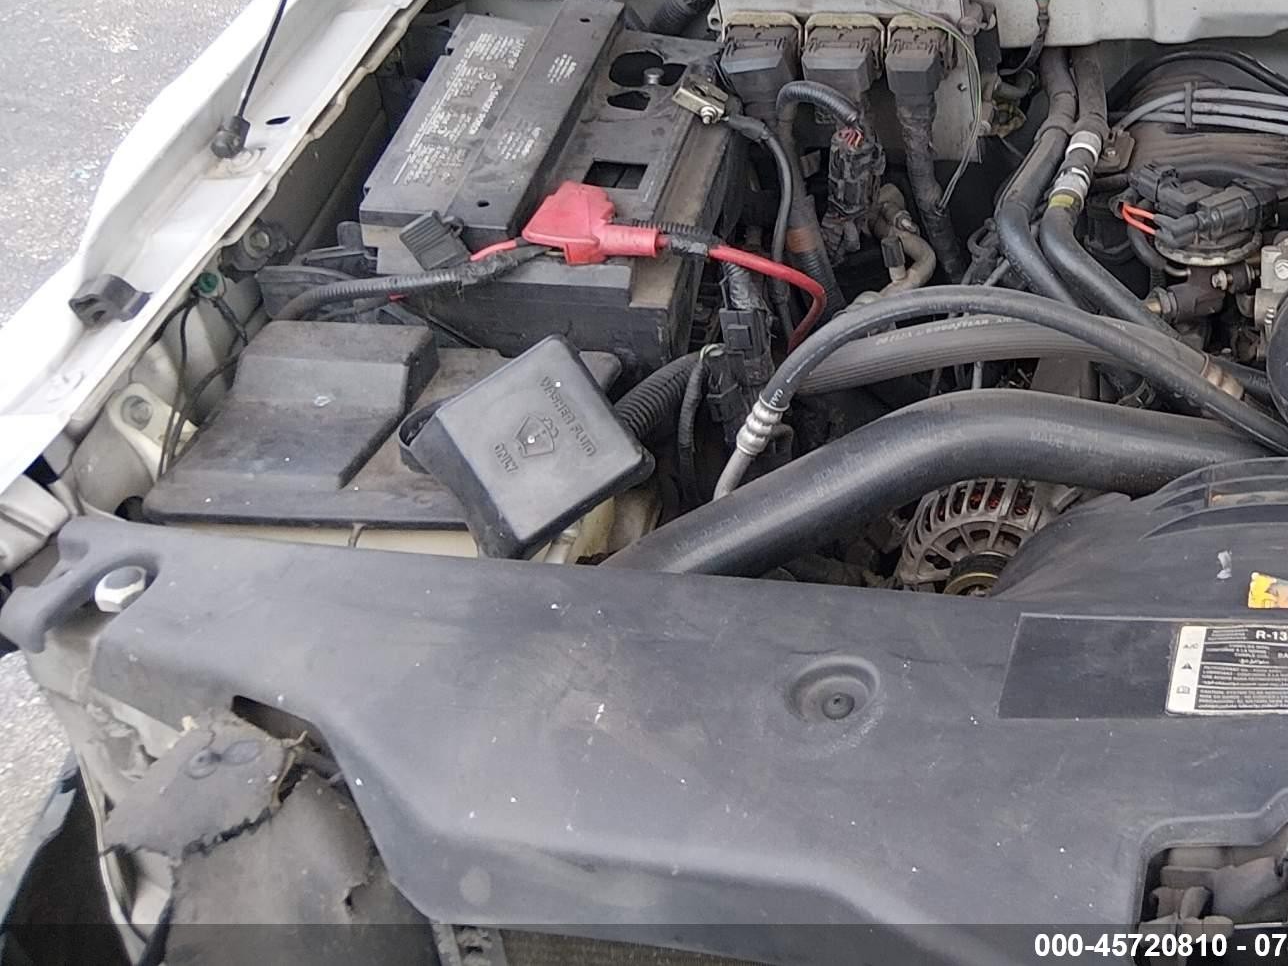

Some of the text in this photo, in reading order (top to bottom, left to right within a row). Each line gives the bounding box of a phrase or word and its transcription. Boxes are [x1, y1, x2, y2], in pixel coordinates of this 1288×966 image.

[540, 376, 597, 457] WASHER FLUID
[494, 443, 519, 473] ONLY
